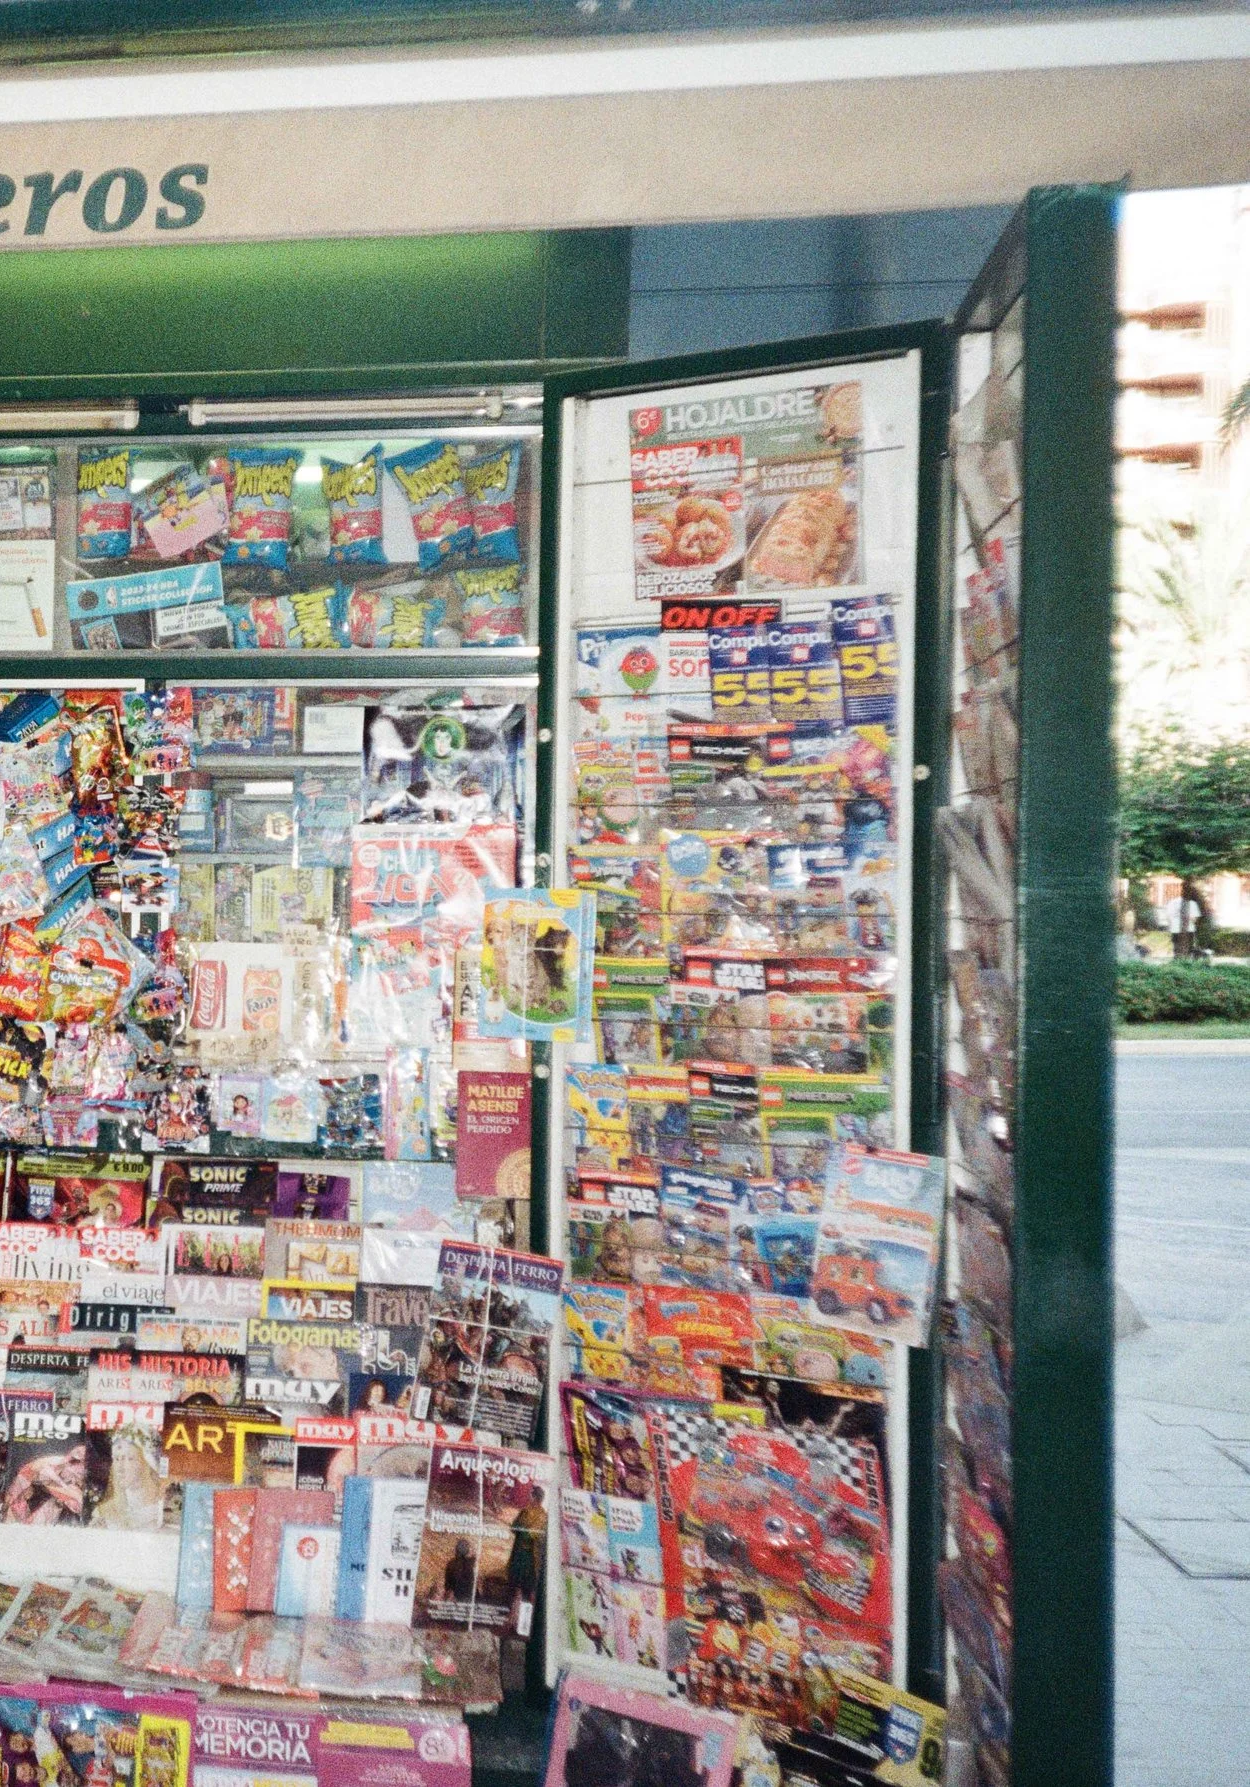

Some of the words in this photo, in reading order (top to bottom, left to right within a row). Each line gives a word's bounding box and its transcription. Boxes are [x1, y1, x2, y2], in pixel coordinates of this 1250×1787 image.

[666, 389, 816, 431] HOJALDRE
[632, 446, 699, 471] SABER
[637, 571, 716, 587] REBOZADOS
[638, 584, 714, 597] DELICIOSOS
[662, 607, 709, 629] ON
[711, 605, 780, 626] OFF
[467, 1084, 524, 1100] MATILDE
[467, 1099, 518, 1114] ASENSI
[467, 1115, 479, 1126] EL
[482, 1116, 520, 1127] ORIGEN
[467, 1123, 512, 1135] PERDIDO
[189, 1165, 247, 1183] SONIC
[203, 1182, 243, 1194] PRIME
[182, 1207, 239, 1225] SONIC
[81, 1227, 146, 1247] SABER
[444, 1251, 507, 1275] DESPERTA
[514, 1263, 558, 1284] FERRO
[102, 1281, 119, 1299] el
[281, 1299, 353, 1319] VIAJES
[250, 1319, 362, 1349] Fotogramas
[11, 1352, 69, 1368] DESPERTA
[139, 1355, 231, 1377] HISTORIA
[459, 1361, 471, 1373] La
[472, 1364, 510, 1381] Guerra
[246, 1379, 341, 1405] muy
[7, 1397, 49, 1412] FERRO
[299, 1424, 355, 1440] muy
[360, 1417, 474, 1445] muy
[430, 1509, 480, 1527] Hispania
[285, 1721, 310, 1740] TU
